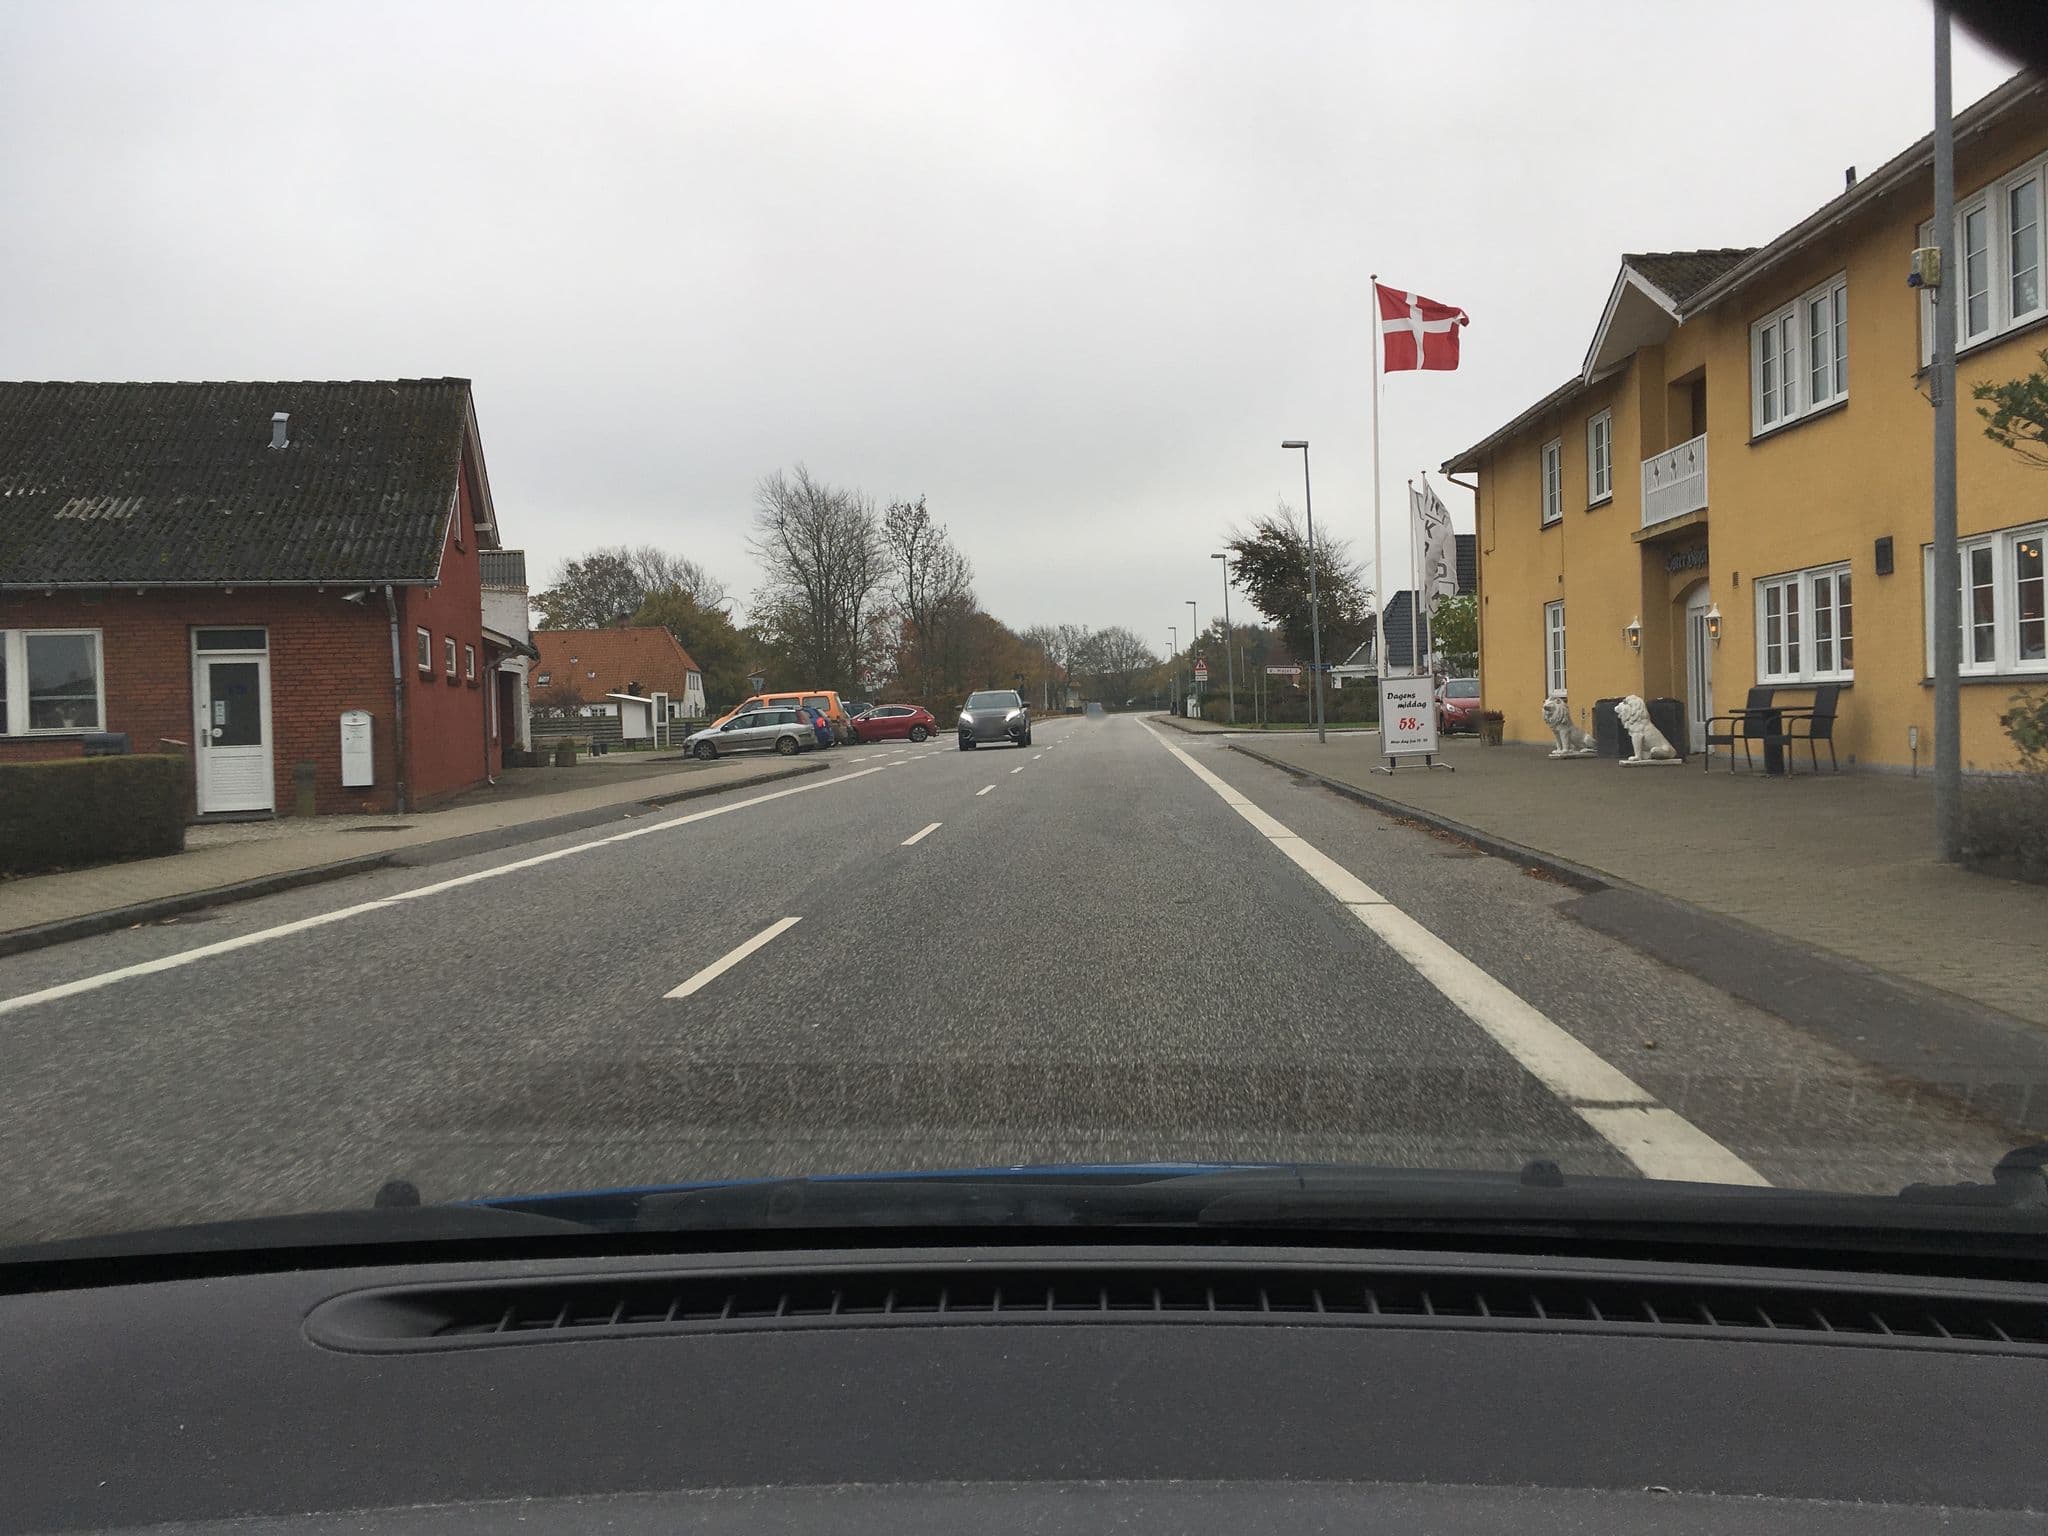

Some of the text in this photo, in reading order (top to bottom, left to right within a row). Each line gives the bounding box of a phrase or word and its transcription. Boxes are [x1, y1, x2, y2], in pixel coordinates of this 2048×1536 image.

[1387, 692, 1416, 700] Dagens
[1397, 701, 1427, 709] middag
[1399, 717, 1425, 731] 58,-
